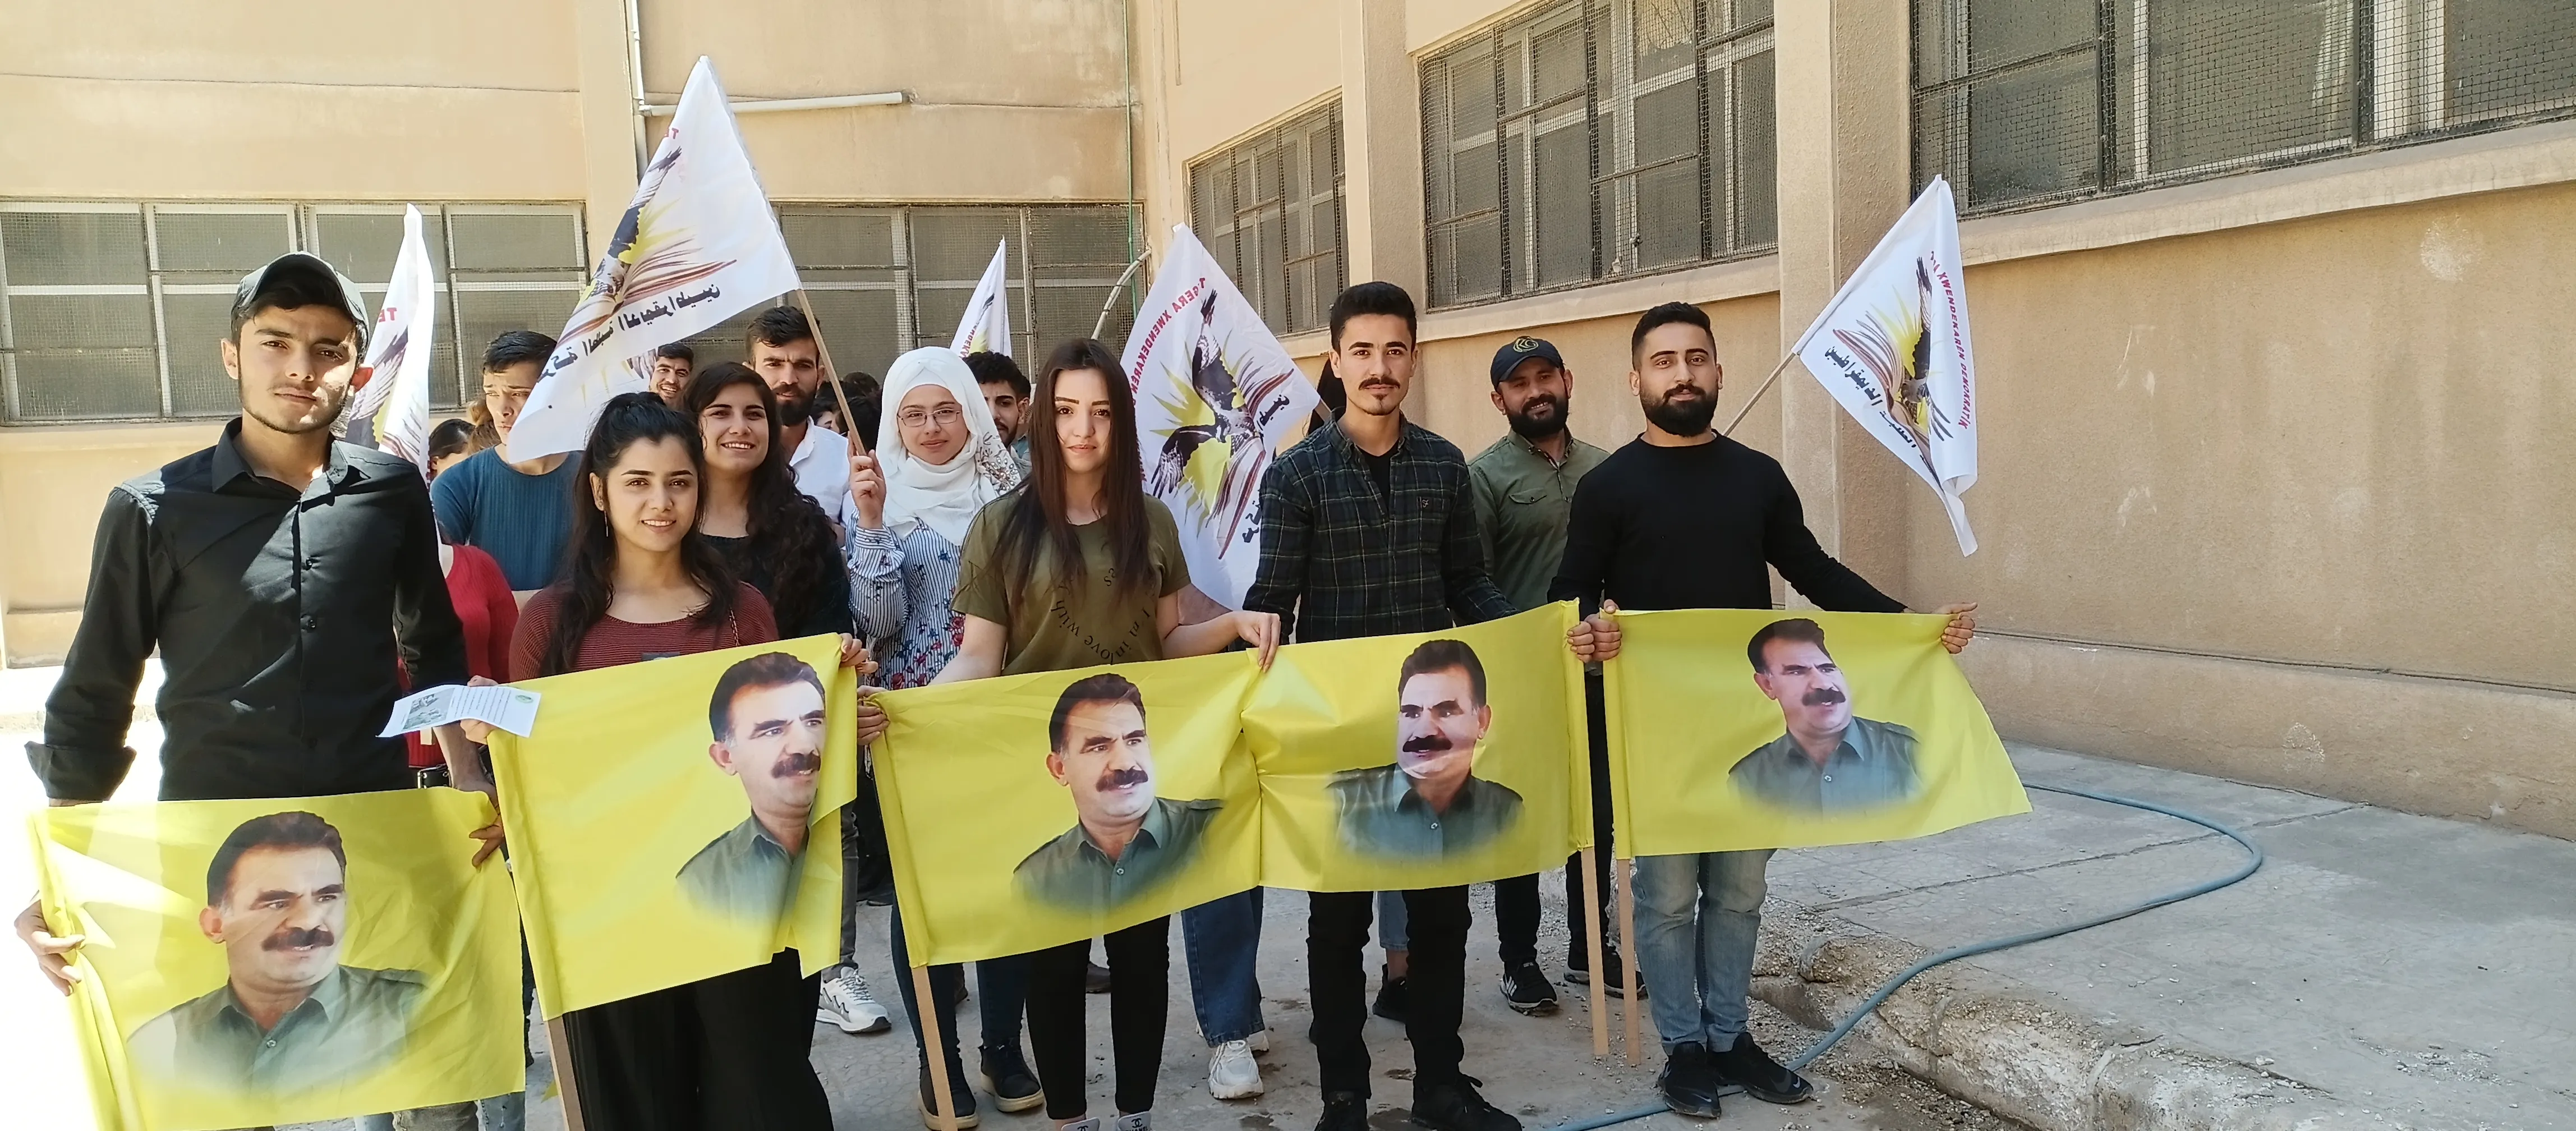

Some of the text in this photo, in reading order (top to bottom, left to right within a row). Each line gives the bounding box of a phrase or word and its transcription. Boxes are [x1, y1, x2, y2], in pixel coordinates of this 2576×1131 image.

[1937, 272, 1966, 360] XWENDEKARÊN
[1824, 346, 1883, 406] الديمقراطيين
[1050, 600, 1080, 637] with
[1084, 635, 1114, 666] love
[1115, 640, 1131, 658] in
